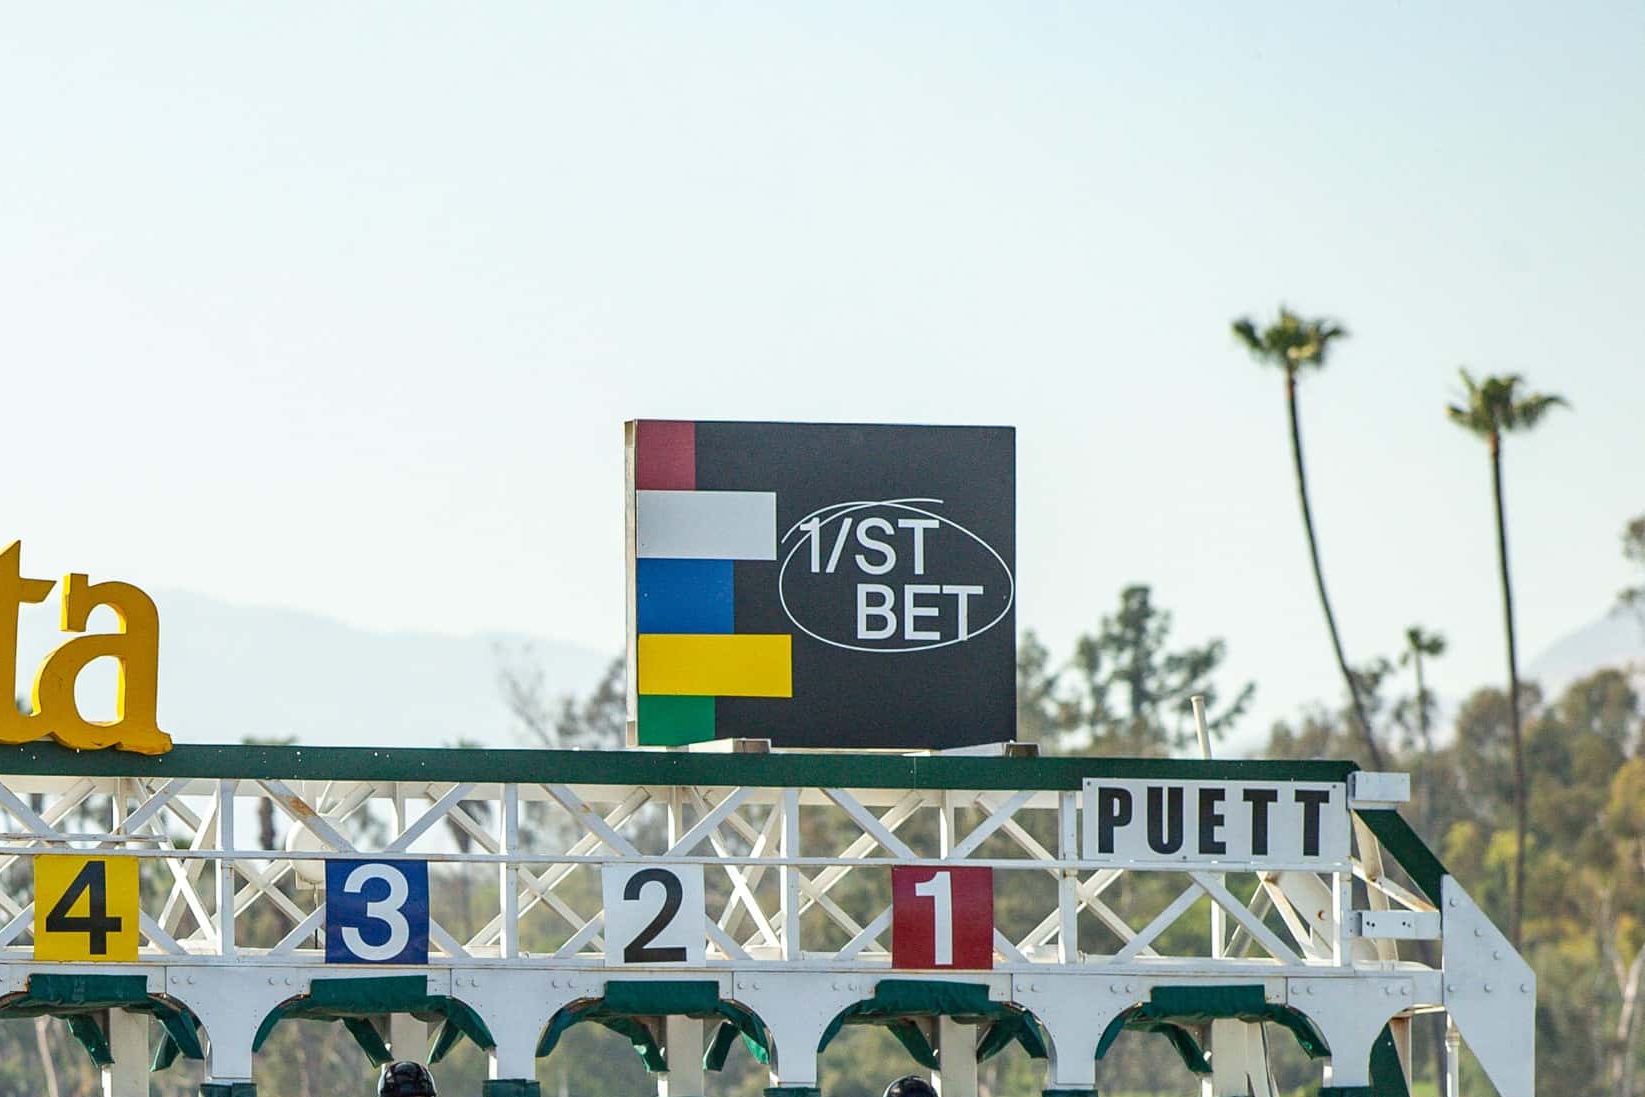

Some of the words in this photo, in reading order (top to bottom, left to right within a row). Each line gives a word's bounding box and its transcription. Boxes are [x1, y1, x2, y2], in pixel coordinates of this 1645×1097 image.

[799, 516, 940, 575] 1/ST
[856, 583, 984, 641] BET
[1098, 786, 1330, 857] PUETT
[45, 860, 123, 955] 4
[341, 864, 409, 961] 3
[623, 868, 688, 963] 2
[911, 871, 953, 965] 1
